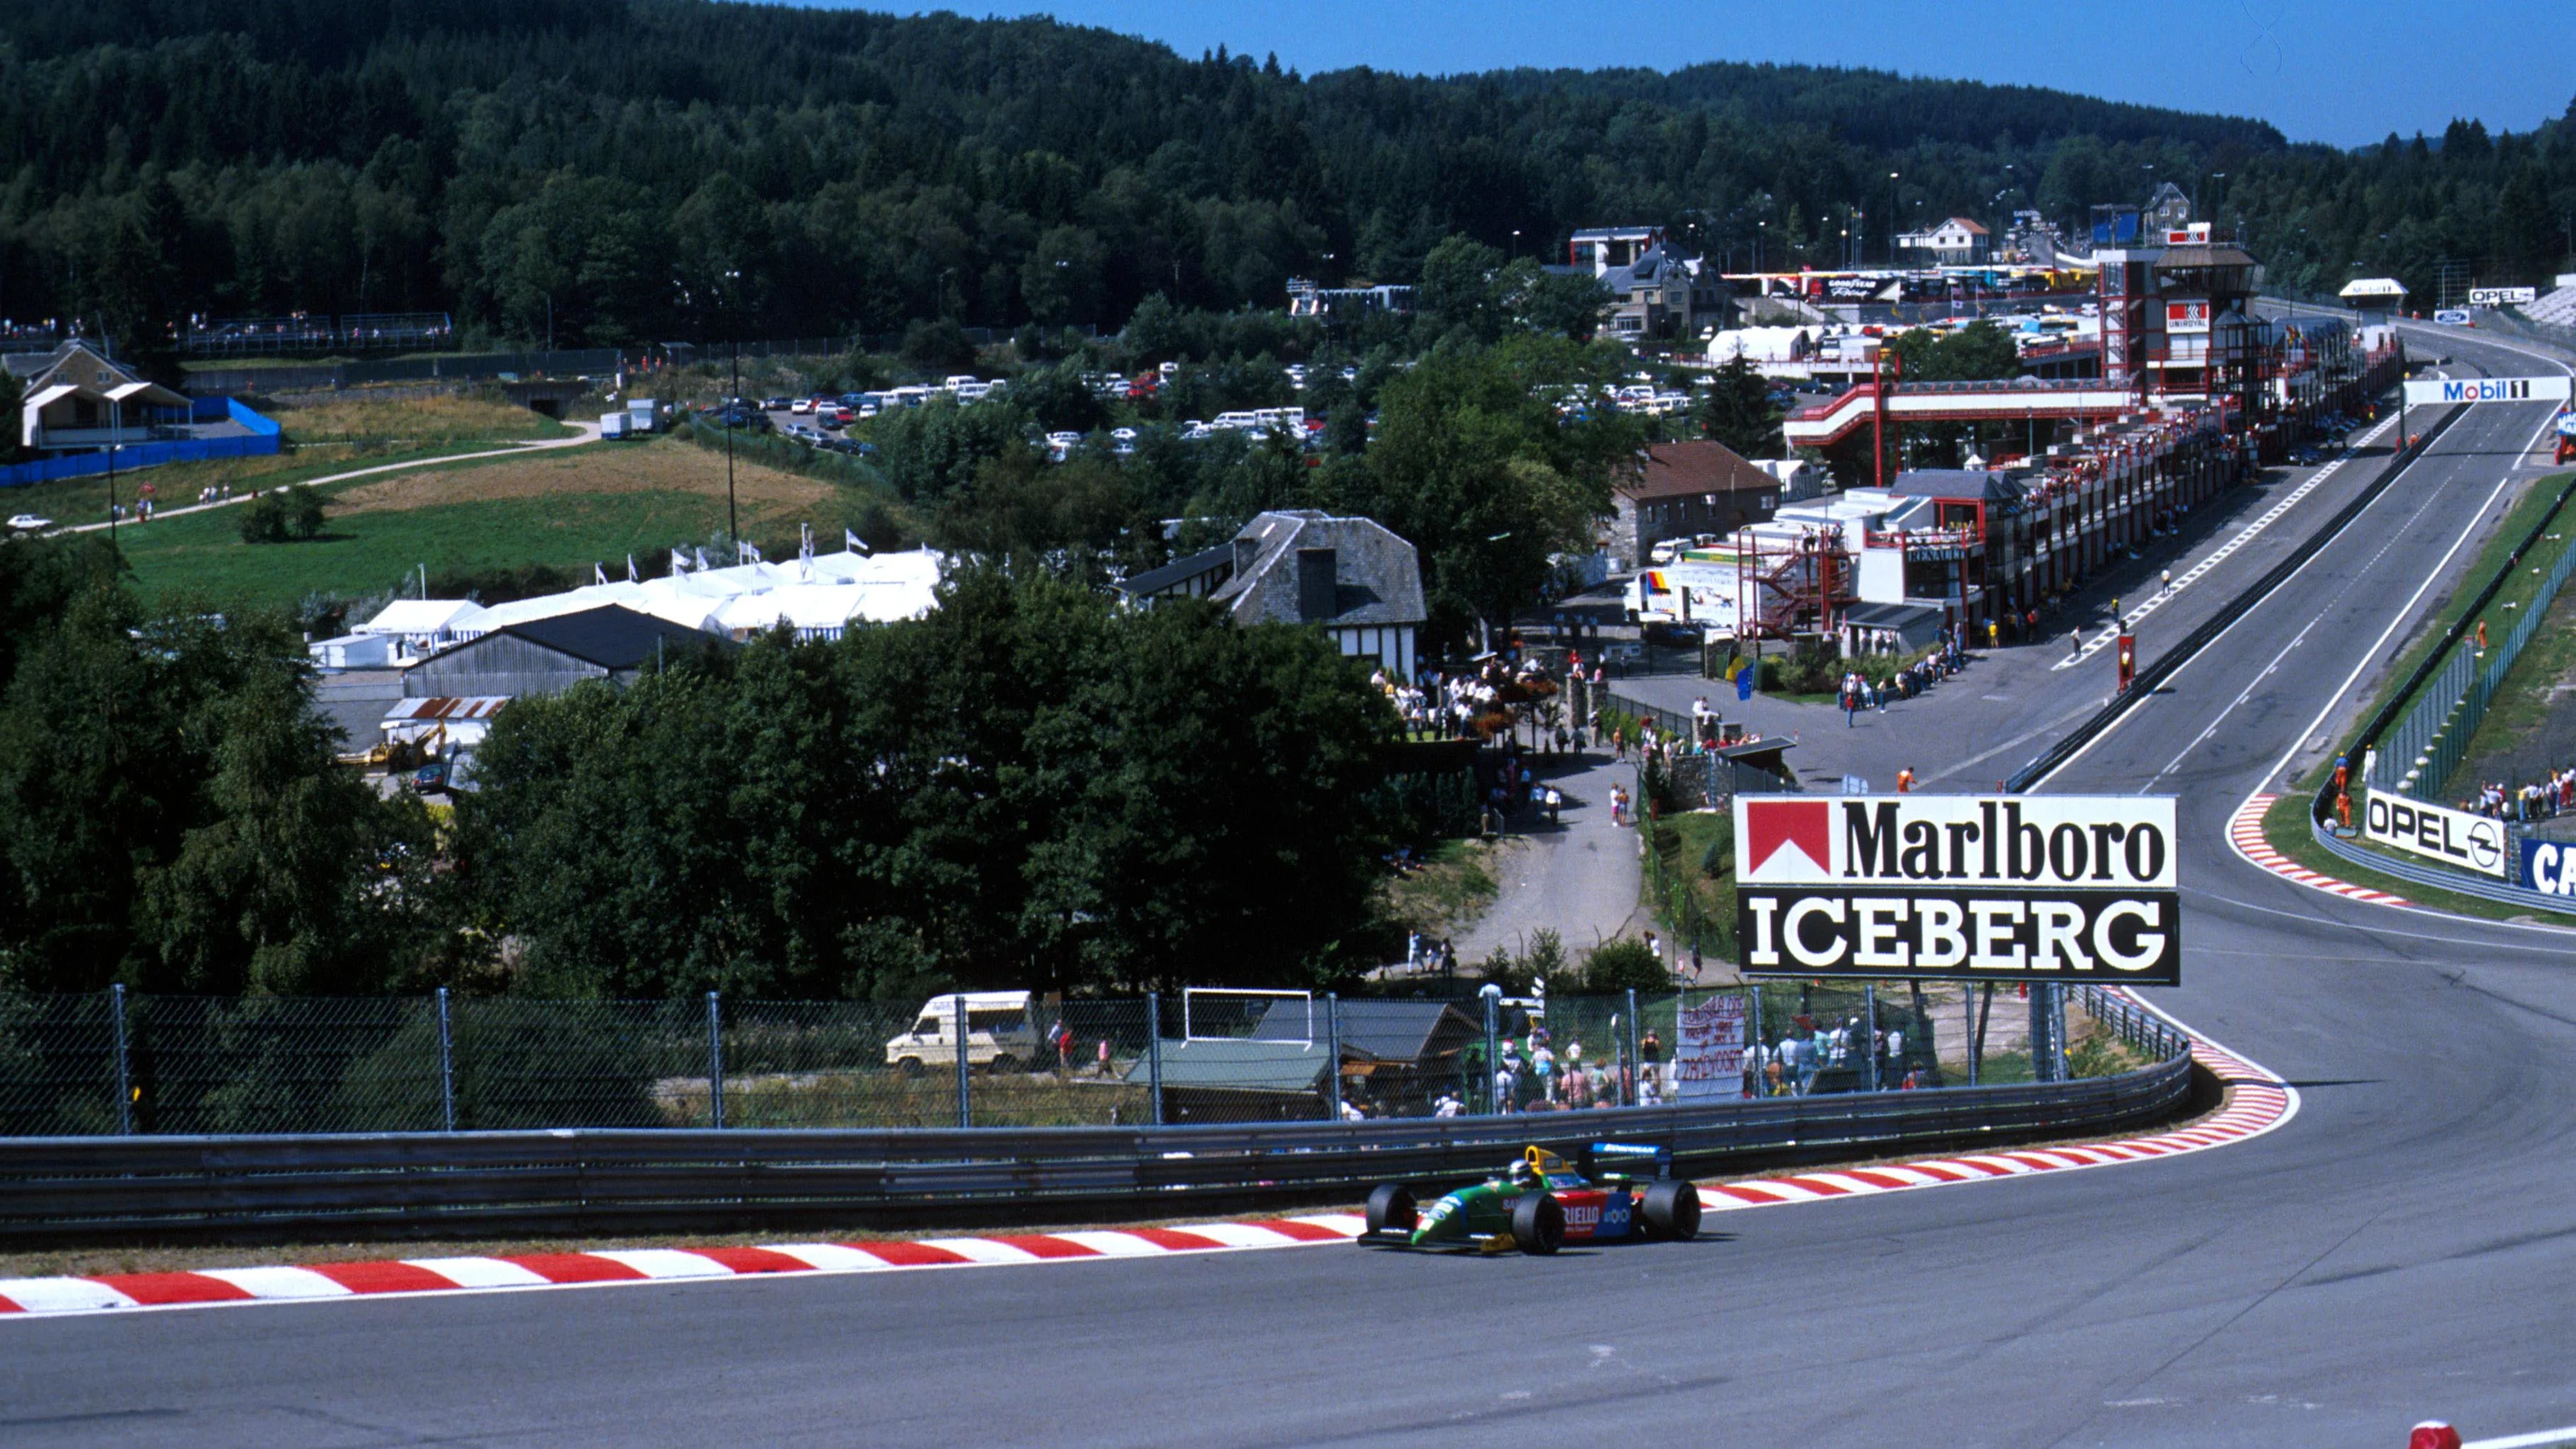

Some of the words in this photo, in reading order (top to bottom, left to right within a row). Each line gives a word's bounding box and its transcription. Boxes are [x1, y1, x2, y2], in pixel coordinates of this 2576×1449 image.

[2472, 291, 2518, 301] OPEL
[2169, 320, 2207, 328] UNIROYAL
[2444, 381, 2507, 400] Mobil
[2512, 380, 2527, 398] 1
[1907, 549, 1965, 563] RENAULT
[2369, 797, 2468, 859] OPEL
[1842, 801, 2165, 881] Marlboro
[1748, 898, 2165, 971] ICEBERG
